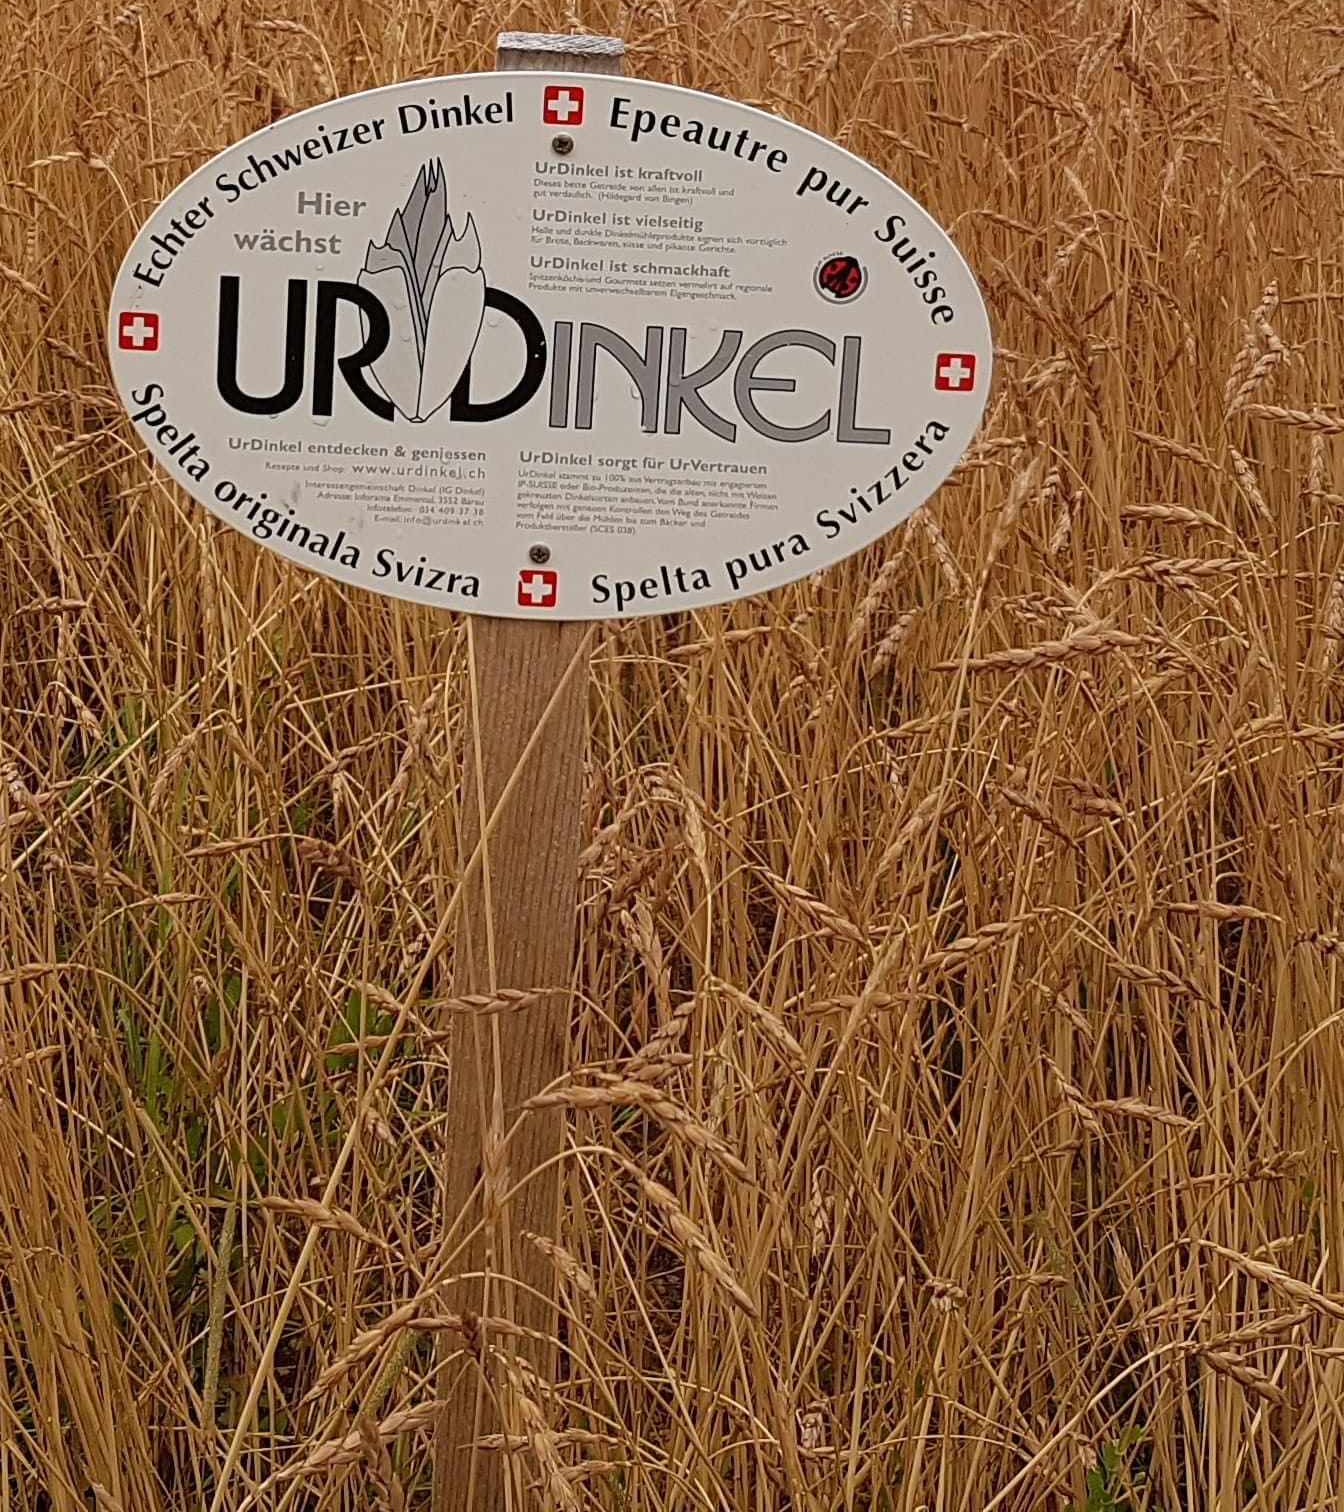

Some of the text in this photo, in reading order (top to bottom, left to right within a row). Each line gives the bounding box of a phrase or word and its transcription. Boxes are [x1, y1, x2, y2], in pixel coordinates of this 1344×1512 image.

[535, 161, 703, 182] UrDinkel ist kraftvoll
[133, 92, 513, 287] Echter Schweizer Dinkel
[598, 191, 641, 202] (Hildegard
[682, 186, 716, 196] kraftvoll
[719, 188, 735, 197] und
[298, 191, 367, 217] Hier
[610, 97, 954, 325] Epeautre pur Suisse
[533, 208, 703, 233] UrDinkel ist vielseitig
[233, 229, 342, 255] wächst
[530, 255, 731, 278] UrDinkel ist schmackhaft
[228, 437, 302, 453] UrDinkel
[308, 443, 389, 457] entdecken
[394, 445, 406, 457] &
[303, 463, 319, 472] und
[520, 450, 767, 474] UrDinkel sorgt für UrVertrauen
[131, 383, 480, 598] Spelta originala Svizra
[591, 420, 951, 612] Spelta pura Svizzera
